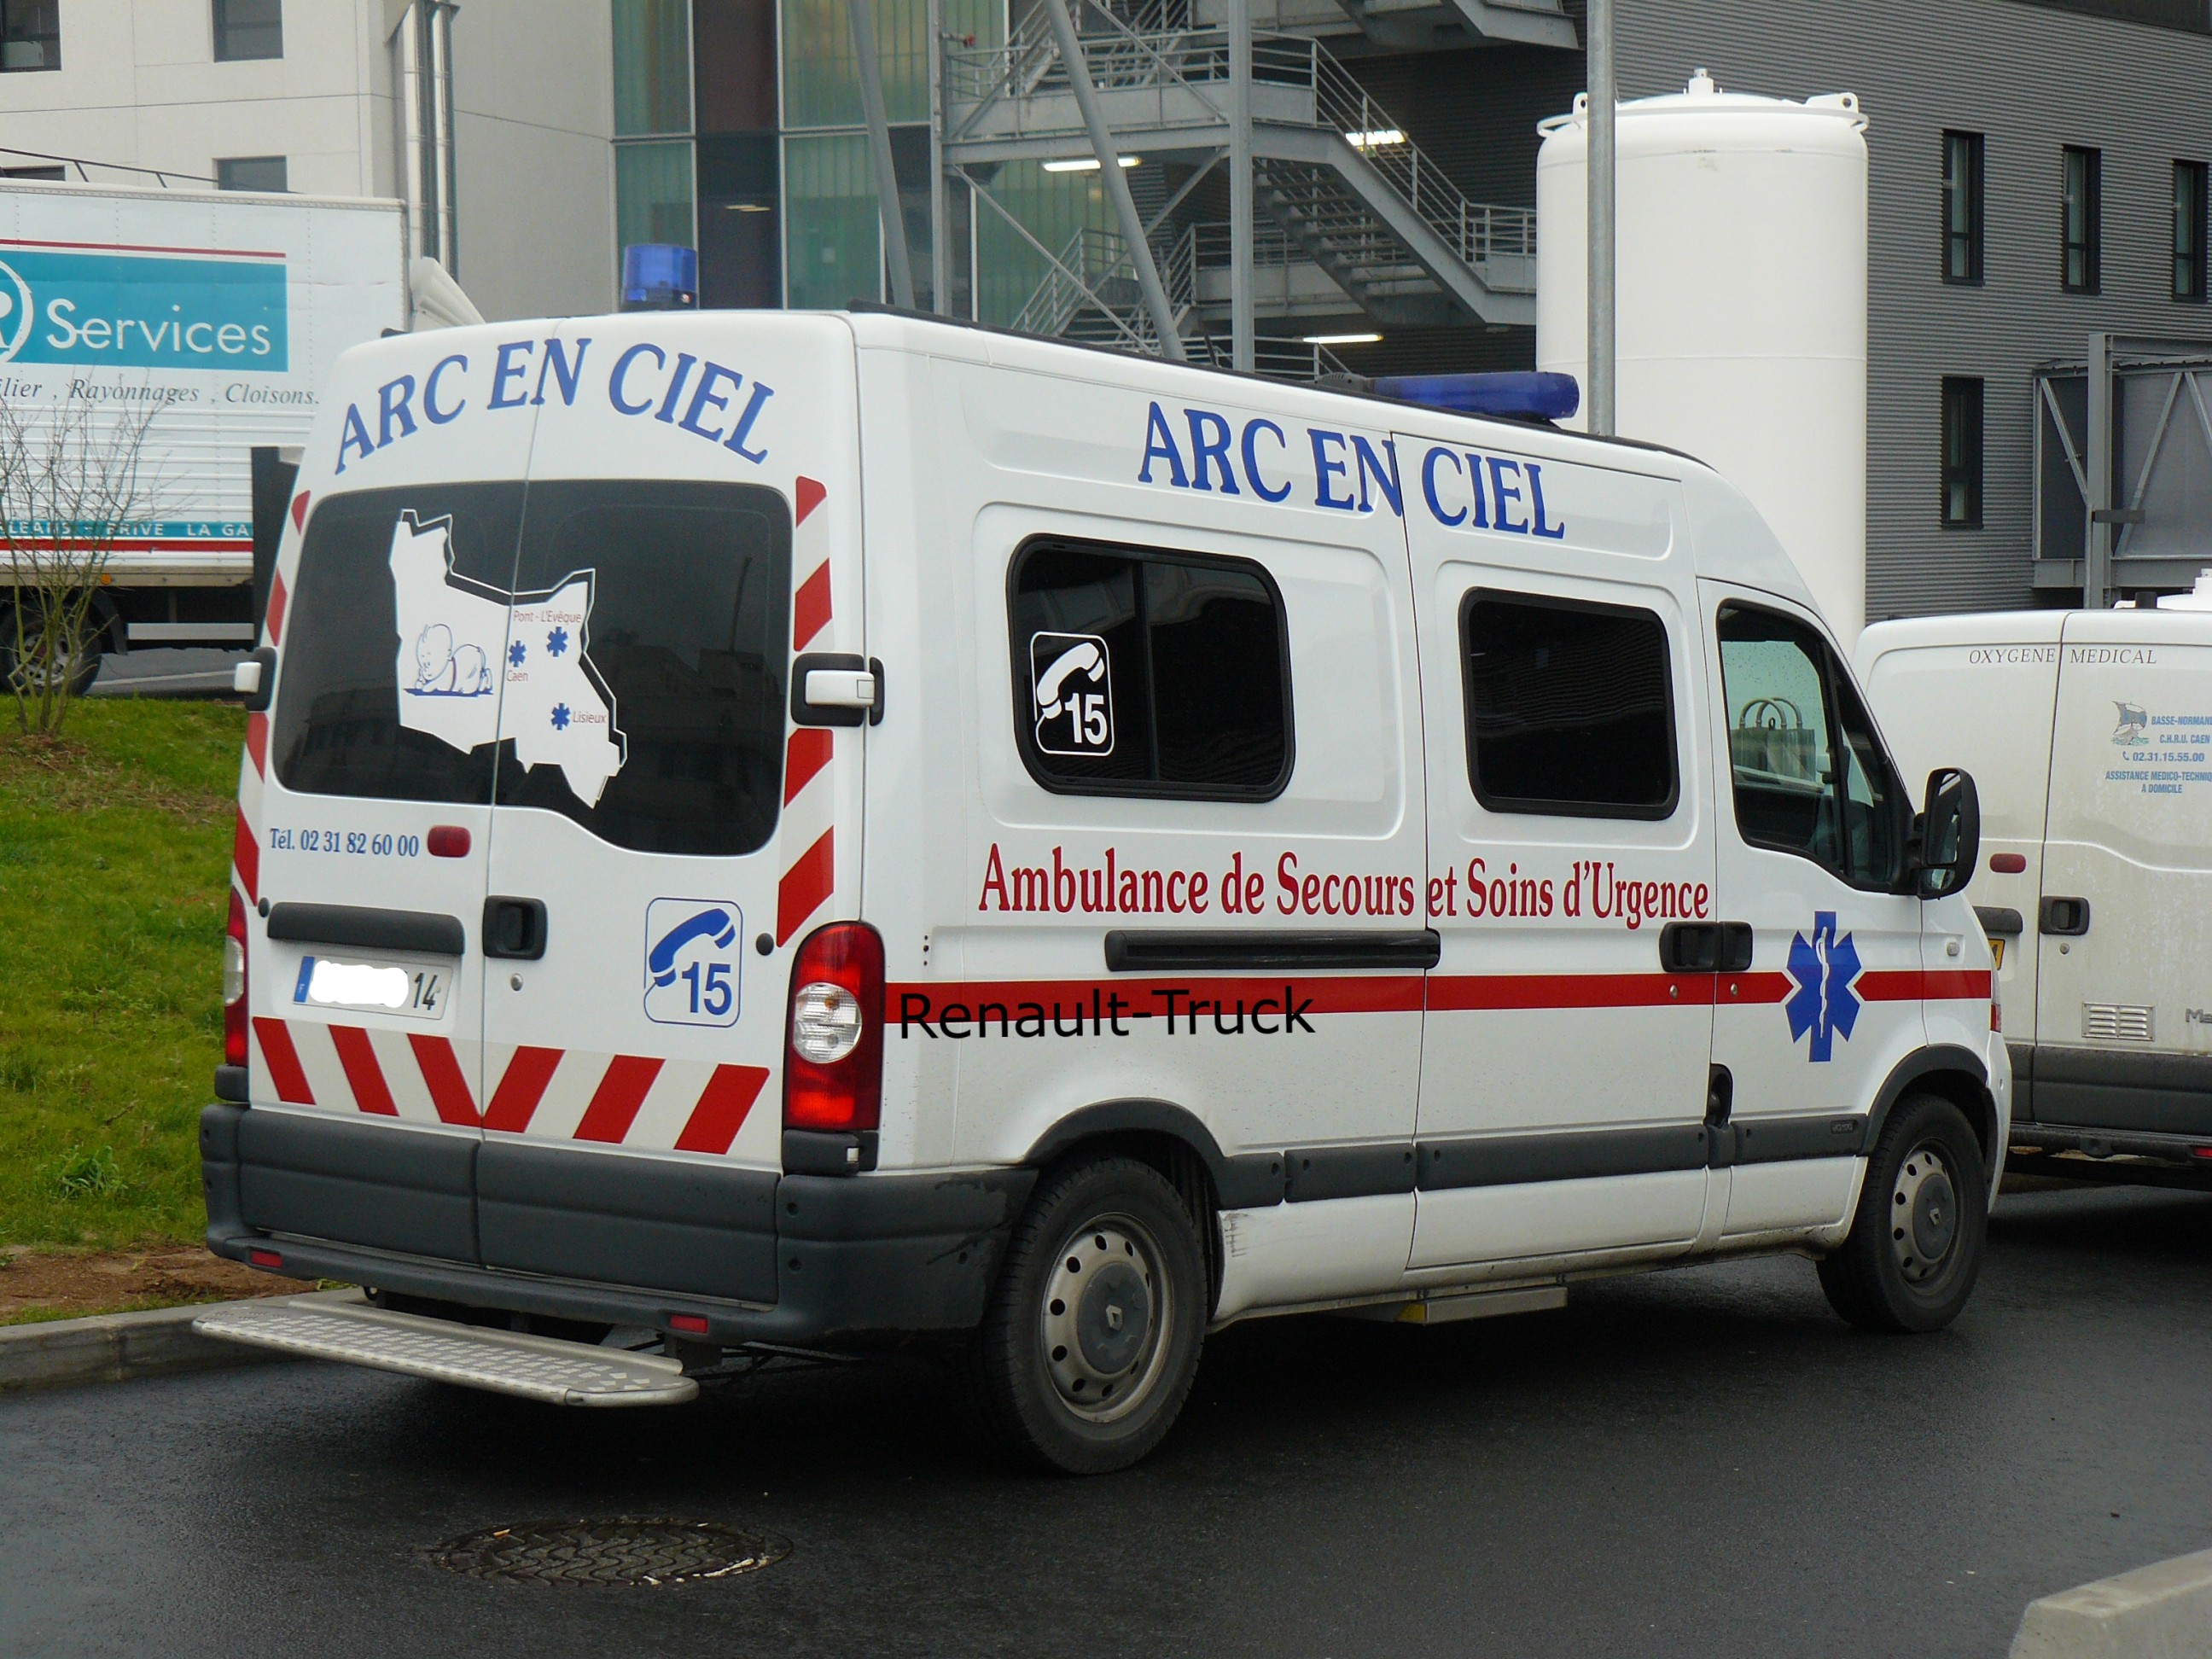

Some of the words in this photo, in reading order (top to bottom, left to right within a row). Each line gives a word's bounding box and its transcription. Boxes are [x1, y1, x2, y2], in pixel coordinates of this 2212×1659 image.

[46, 299, 271, 355] Services
[0, 376, 43, 399] lier
[70, 378, 200, 405] Rayonnages
[225, 382, 320, 405] Cloisons.
[335, 355, 469, 475] ARC
[487, 338, 592, 410] EN
[609, 343, 775, 465] CIEL
[1138, 401, 1293, 504] ARC
[1307, 428, 1403, 517] EN
[1422, 446, 1566, 539] CIEL
[187, 524, 212, 536] LA
[513, 610, 533, 623] Pont
[1969, 649, 2056, 665] OXYGENE
[2070, 649, 2158, 665] MEDICAL
[507, 670, 529, 682] Caen
[573, 711, 607, 724] Lisieux
[1064, 692, 1108, 745] 15
[2191, 735, 2210, 744] CAEN
[2133, 752, 2205, 762] 02.31.15.55.00
[2105, 771, 2149, 780] ASSISTANCE
[2141, 784, 2146, 793] A
[2148, 784, 2182, 794] DOMICILE
[271, 828, 295, 850] Tél.
[300, 830, 319, 852] 02
[323, 830, 341, 853] 31
[346, 832, 366, 854] 82
[372, 833, 393, 856] 60
[398, 835, 419, 857] 00
[978, 842, 1208, 914] Ambulance
[1220, 851, 1265, 915] de
[1277, 851, 1415, 916] Secours
[1428, 866, 1458, 917] et
[1467, 857, 1553, 917] Soins
[1563, 859, 1708, 930] d'Urgence
[413, 972, 438, 1010] 14
[682, 961, 732, 1016] 15
